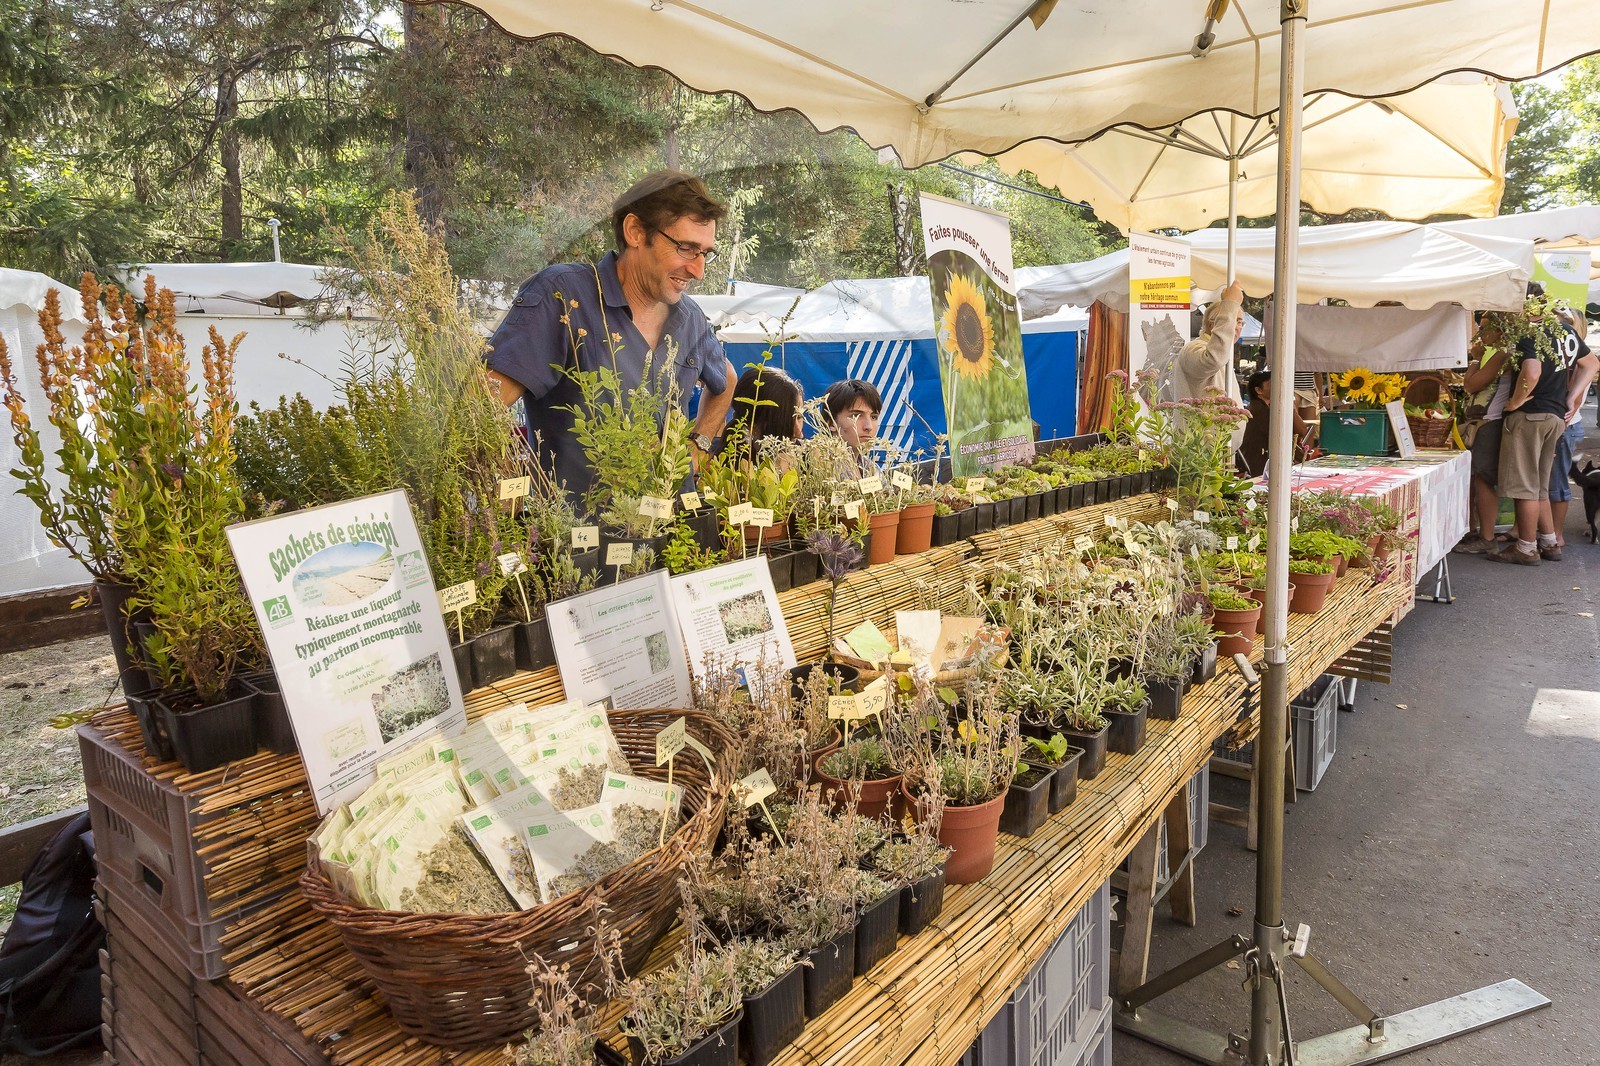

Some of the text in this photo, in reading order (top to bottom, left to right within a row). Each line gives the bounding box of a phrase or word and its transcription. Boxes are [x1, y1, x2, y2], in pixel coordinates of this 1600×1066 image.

[929, 225, 1008, 284] Faites pousser une ferme
[960, 434, 1027, 455] ÉCONOMIE SOCIALE ET SOLIDAIRE
[978, 452, 996, 465] FONCIER
[269, 512, 399, 583] sachets de génépi
[441, 584, 465, 597] HYSOPE
[269, 600, 289, 621] AB
[305, 613, 350, 632] Réalisez
[351, 606, 369, 620] une
[371, 590, 401, 613] liqueur
[295, 600, 421, 660] typiquement montagnarde
[308, 620, 423, 678] au parfum incomparable
[863, 695, 883, 710] 5,50
[555, 720, 590, 740] GENEPI
[396, 751, 433, 776] GENEPI
[625, 782, 665, 797] GENEPI
[490, 800, 528, 822] GENEPI
[549, 817, 590, 832] GENEPI
